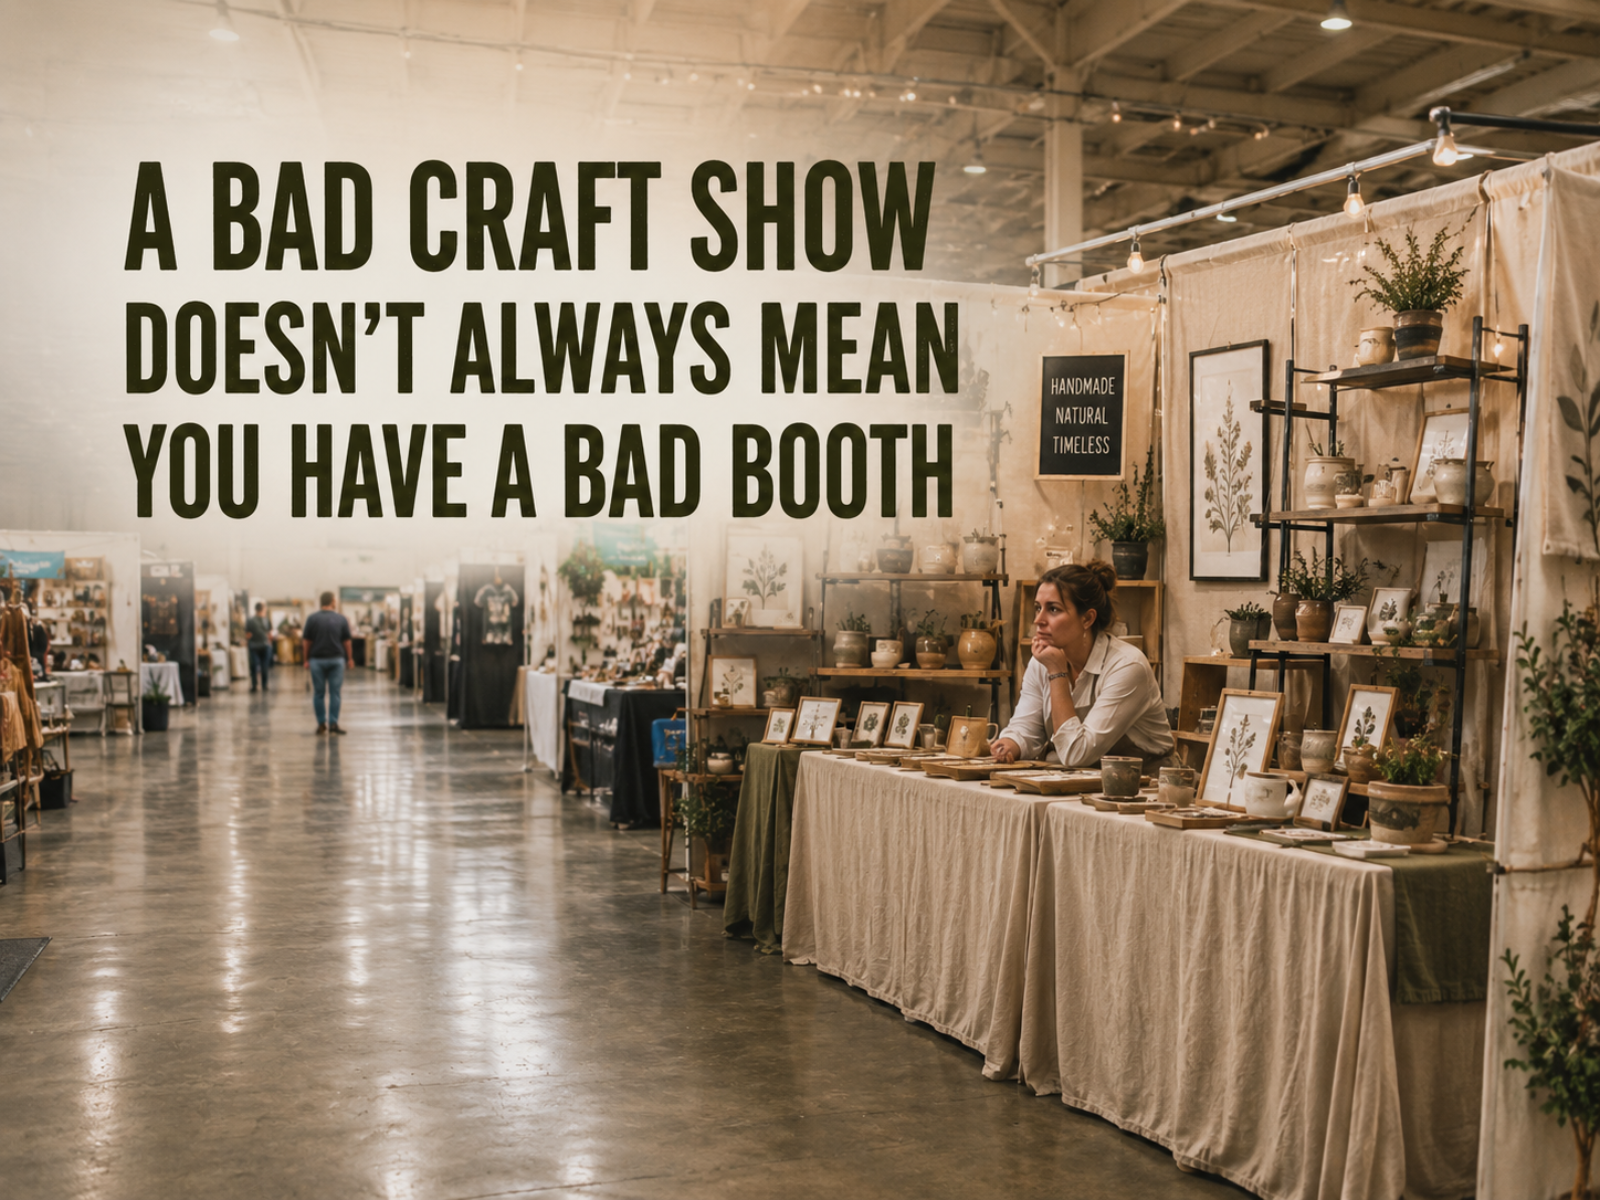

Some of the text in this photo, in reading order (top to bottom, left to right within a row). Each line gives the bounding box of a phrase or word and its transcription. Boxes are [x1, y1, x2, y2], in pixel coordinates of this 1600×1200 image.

[1051, 377, 1115, 395] HANDMADE
[1055, 406, 1108, 425] NATURAL
[1053, 436, 1110, 454] TIMELESS
